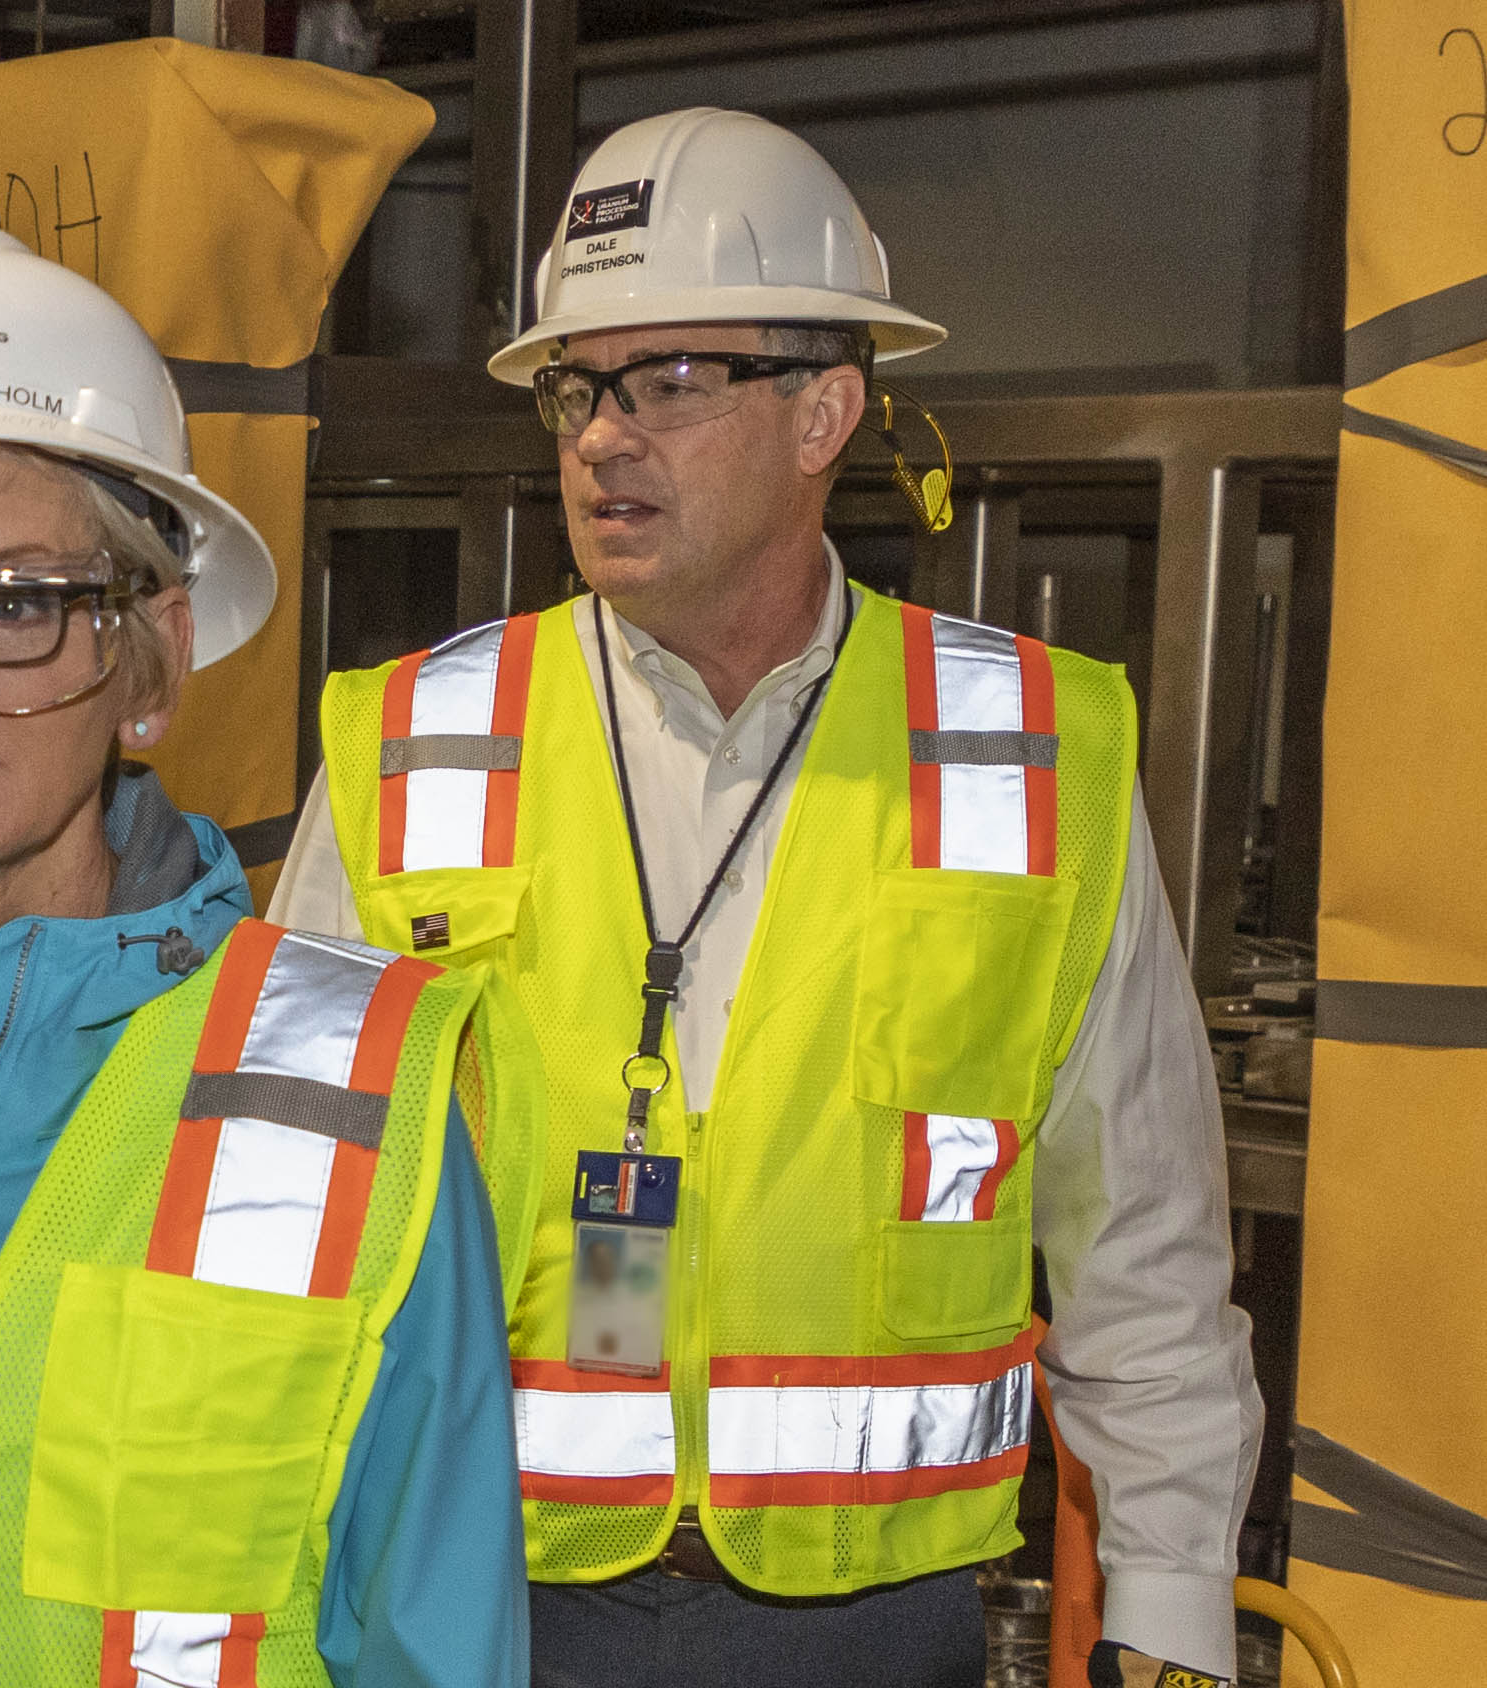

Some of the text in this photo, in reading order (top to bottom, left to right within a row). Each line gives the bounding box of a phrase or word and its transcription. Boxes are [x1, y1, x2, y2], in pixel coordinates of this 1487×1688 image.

[595, 213, 625, 224] FACILITY
[586, 238, 617, 254] DALE
[561, 253, 644, 279] CHRISTENSON
